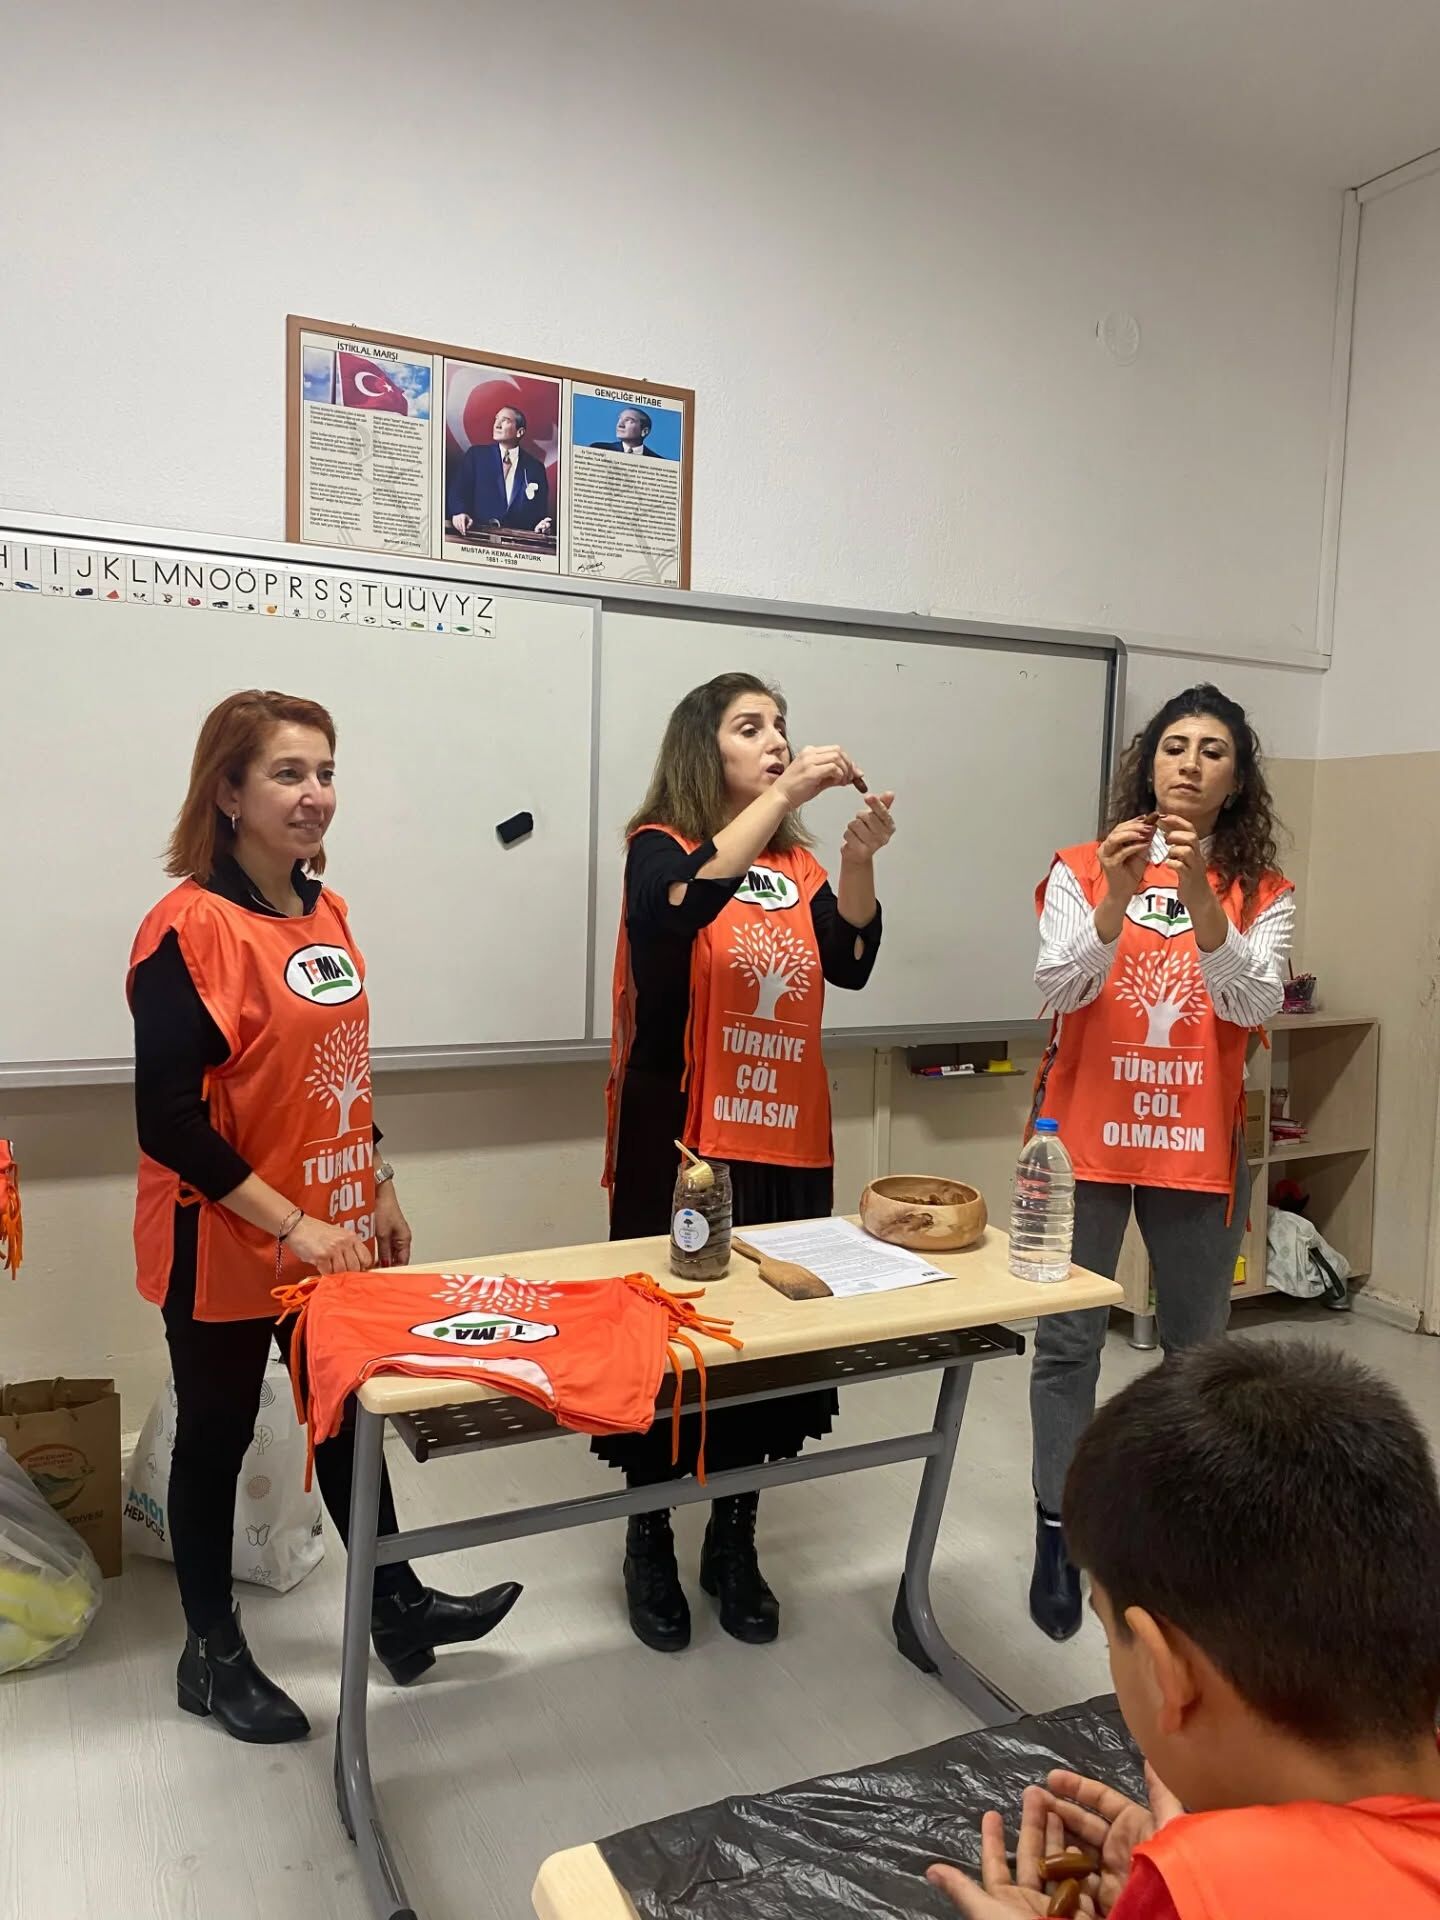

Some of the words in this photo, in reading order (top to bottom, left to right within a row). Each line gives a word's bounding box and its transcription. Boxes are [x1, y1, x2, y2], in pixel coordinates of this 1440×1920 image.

[635, 394, 662, 407] HİTABE
[461, 547, 490, 556] MUSTAFA
[491, 549, 513, 559] KEMAL
[76, 556, 91, 578] J
[104, 556, 120, 580] K
[132, 559, 147, 583] L
[155, 561, 180, 586] M
[184, 566, 203, 588] N
[209, 567, 231, 590] O
[265, 573, 278, 595] P
[290, 576, 303, 599] R
[315, 579, 328, 601] S
[361, 584, 378, 606] T
[384, 587, 402, 609] U
[432, 591, 448, 614] V
[455, 594, 470, 616] Y
[477, 596, 493, 619] Z
[747, 871, 776, 893] MA
[722, 1021, 806, 1063] TÜRKİYE
[736, 1061, 778, 1094] ÇÖL
[1111, 1052, 1204, 1086] TÜRKİYE
[713, 1095, 799, 1129] OLMASIN
[1133, 1088, 1182, 1121] ÇÖL
[1103, 1121, 1205, 1152] OLMASIN
[302, 1137, 374, 1186] TÜRKİY
[329, 1177, 366, 1222] ÇÖL
[123, 1503, 145, 1522] HEP
[145, 1513, 166, 1542] UCUZ
